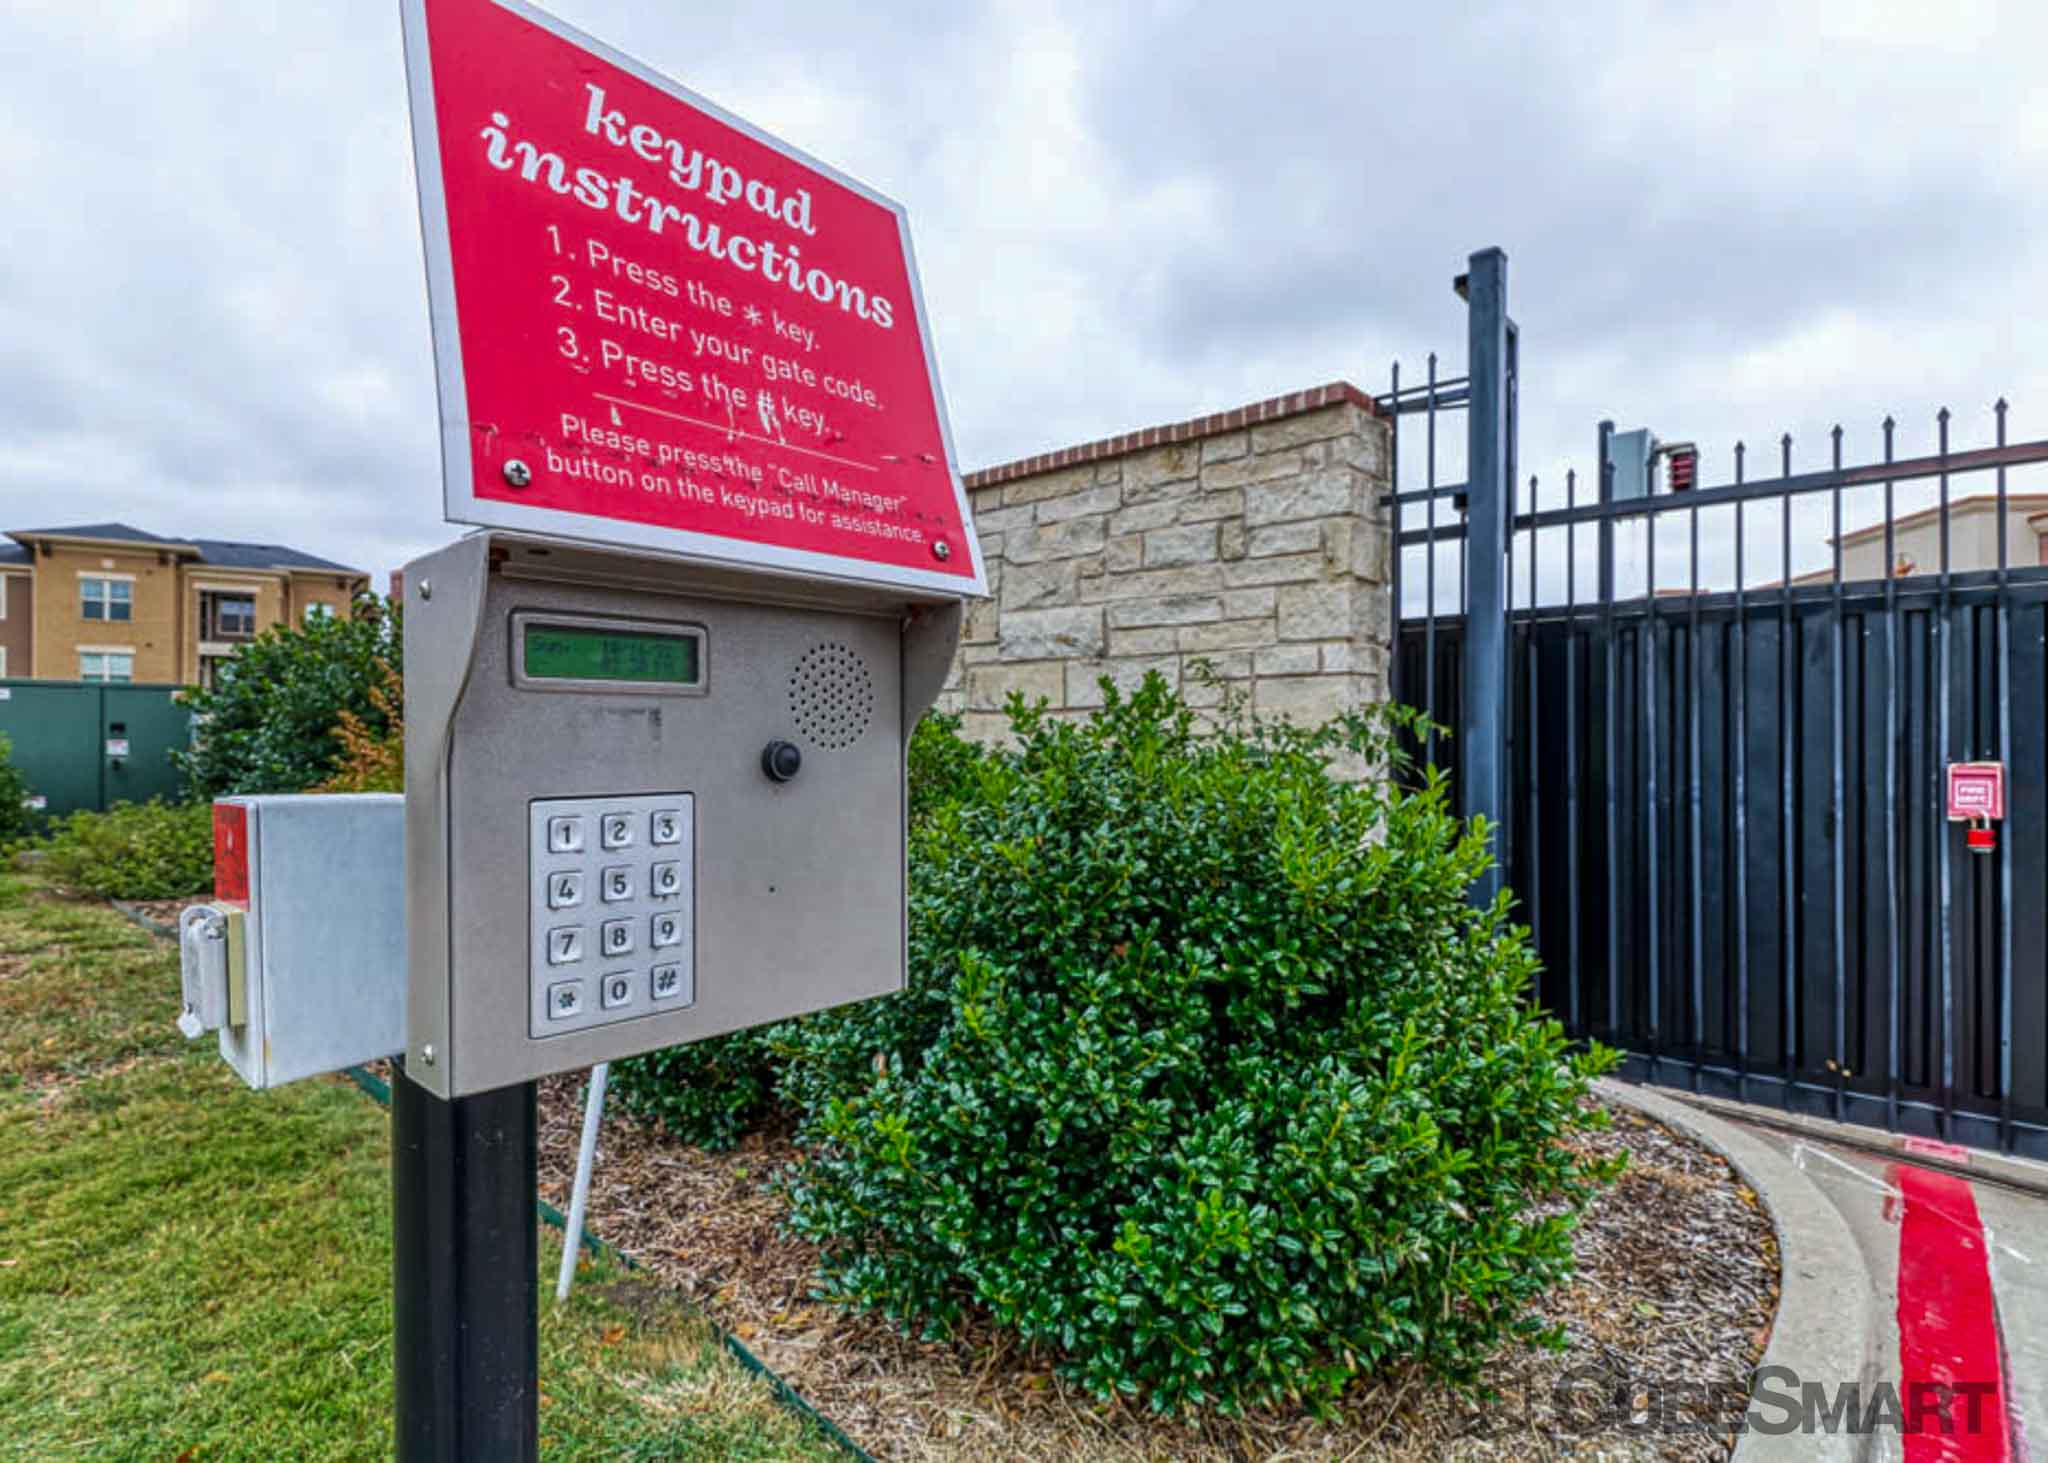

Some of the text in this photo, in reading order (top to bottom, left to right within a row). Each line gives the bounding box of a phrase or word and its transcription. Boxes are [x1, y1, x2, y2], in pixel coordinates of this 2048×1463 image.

[585, 82, 816, 236] keypad
[480, 112, 894, 328] instructions
[547, 224, 576, 260] 1.
[588, 239, 679, 297] Press
[687, 280, 733, 317] the
[773, 310, 821, 352] key.
[551, 275, 885, 411] 2. Enter your gate code.
[557, 327, 590, 363] 3.
[601, 339, 694, 393] Press
[702, 373, 748, 408] the
[782, 396, 832, 436] key.
[547, 447, 927, 544] button on the keypad for assistance.
[561, 413, 650, 455] Please
[658, 443, 722, 473] press
[724, 455, 763, 481] the
[562, 818, 674, 845] 1 2 3
[558, 867, 675, 900] 4 5 6
[560, 920, 675, 956] 7 8 9
[611, 979, 627, 1001] 0
